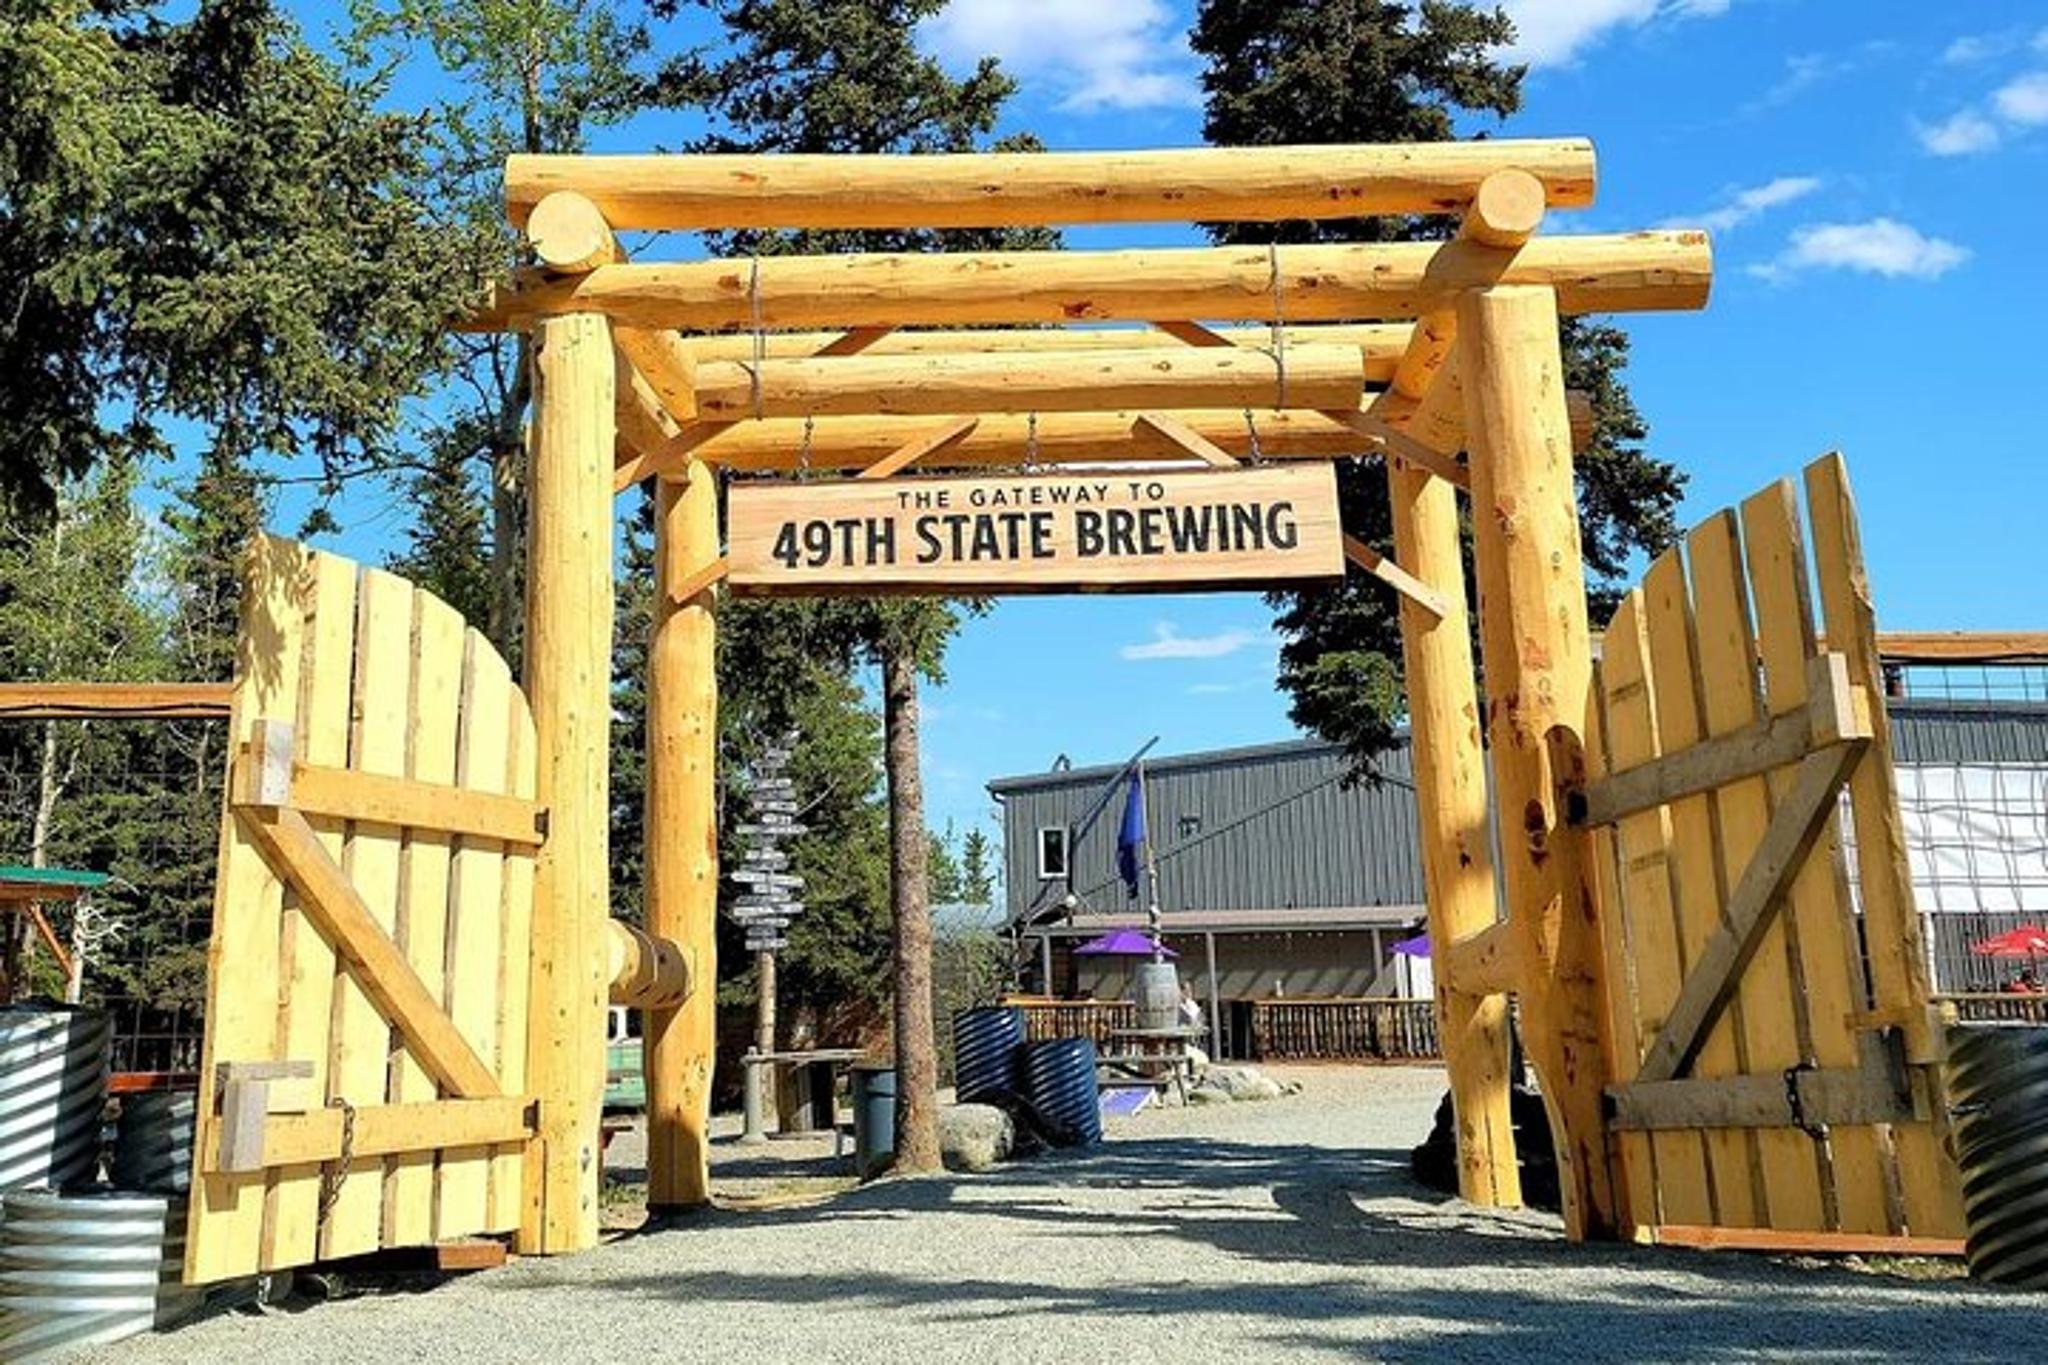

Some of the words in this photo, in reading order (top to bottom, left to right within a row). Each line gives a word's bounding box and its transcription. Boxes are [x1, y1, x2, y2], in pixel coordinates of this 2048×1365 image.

[897, 490, 950, 509] THE
[969, 485, 1108, 507] GATEWAY
[1129, 482, 1165, 501] TO
[772, 517, 896, 569] 49TH
[915, 511, 1056, 564] STATE
[1074, 502, 1298, 558] BREWING
